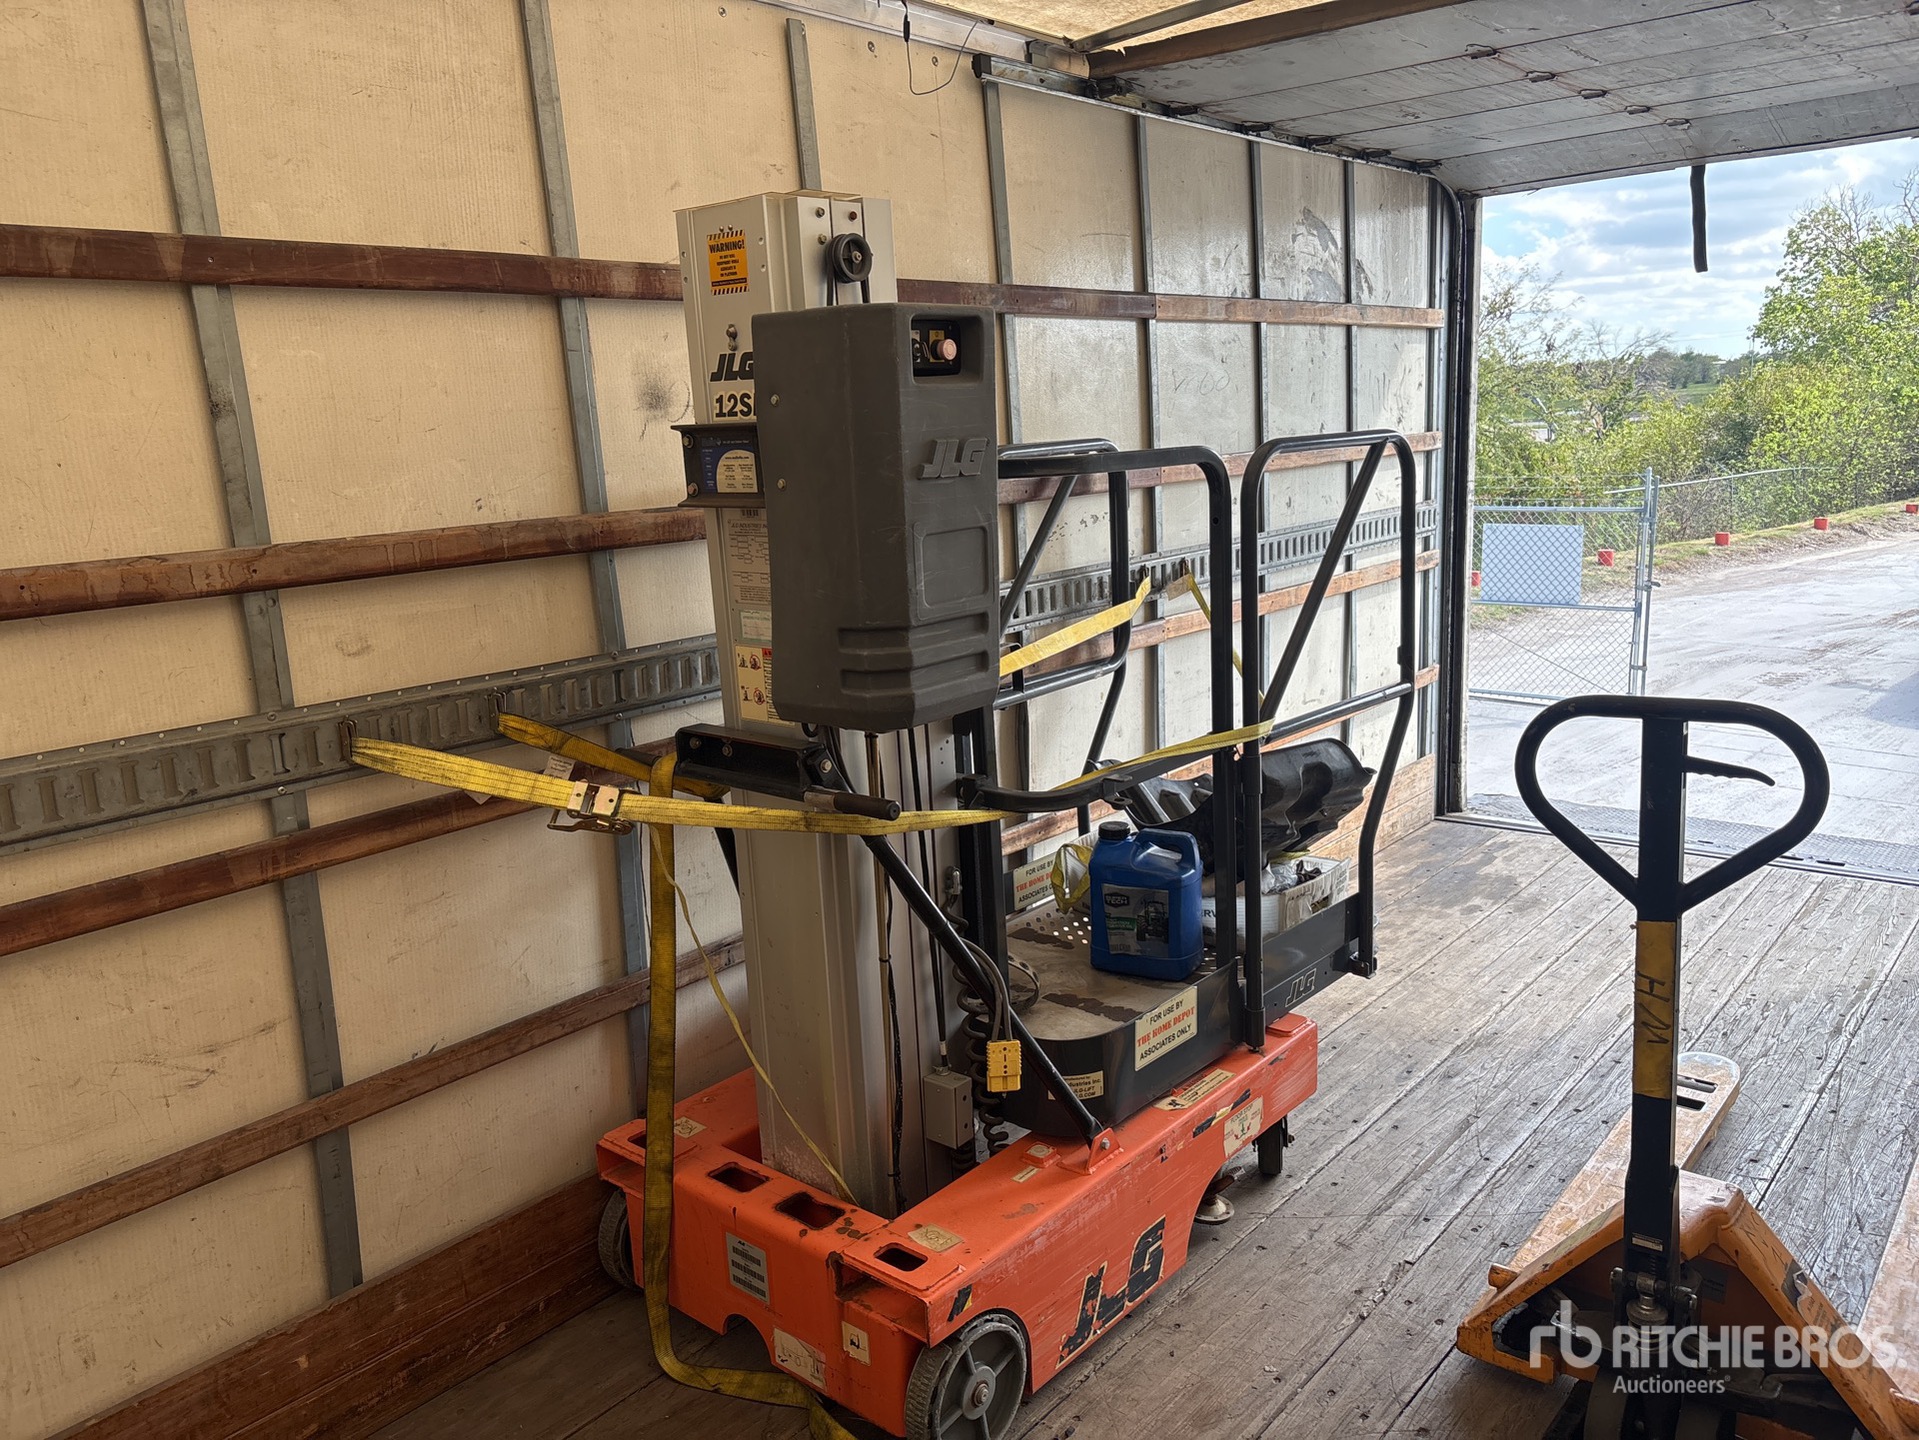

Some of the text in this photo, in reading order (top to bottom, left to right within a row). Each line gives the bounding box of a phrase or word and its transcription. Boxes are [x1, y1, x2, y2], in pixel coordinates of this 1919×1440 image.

[709, 239, 745, 254] WARNING!
[710, 352, 754, 382] JLG
[918, 437, 988, 480] JLG
[1016, 882, 1028, 892] THE
[1029, 875, 1045, 887] HOME
[1026, 867, 1036, 877] FOR
[1037, 862, 1046, 872] USE
[1018, 885, 1049, 903] ASSOCIATES
[1285, 967, 1317, 1008] JLG
[1149, 998, 1184, 1026] FOR USE BY
[1136, 1006, 1195, 1048] THE HOME DEPOT
[1140, 1023, 1192, 1061] ASSOCIATES ONLY
